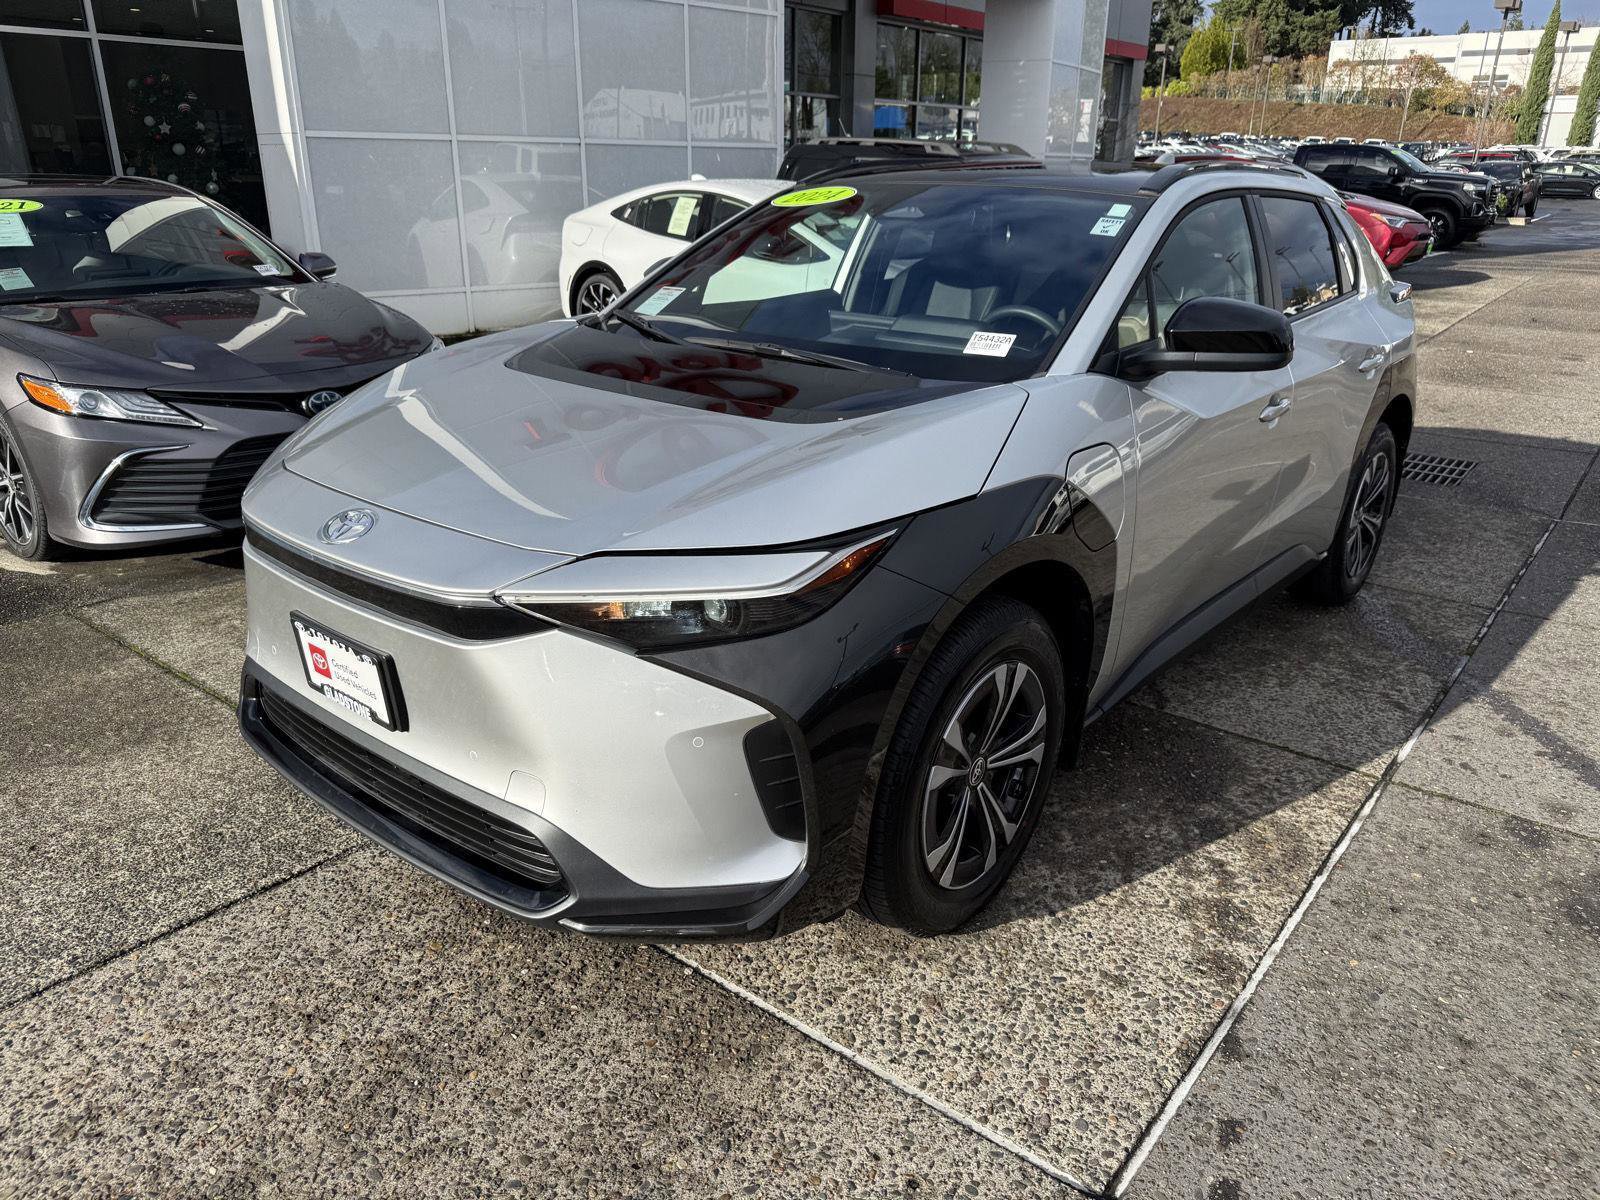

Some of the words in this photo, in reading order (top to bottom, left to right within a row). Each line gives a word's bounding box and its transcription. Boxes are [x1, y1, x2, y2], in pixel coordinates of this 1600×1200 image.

[0, 201, 26, 210] 21
[781, 189, 848, 203] 2024
[331, 658, 359, 679] Certified
[334, 671, 350, 685] Used
[350, 679, 377, 700] Vehicles
[323, 685, 371, 720] GLADSTONE
